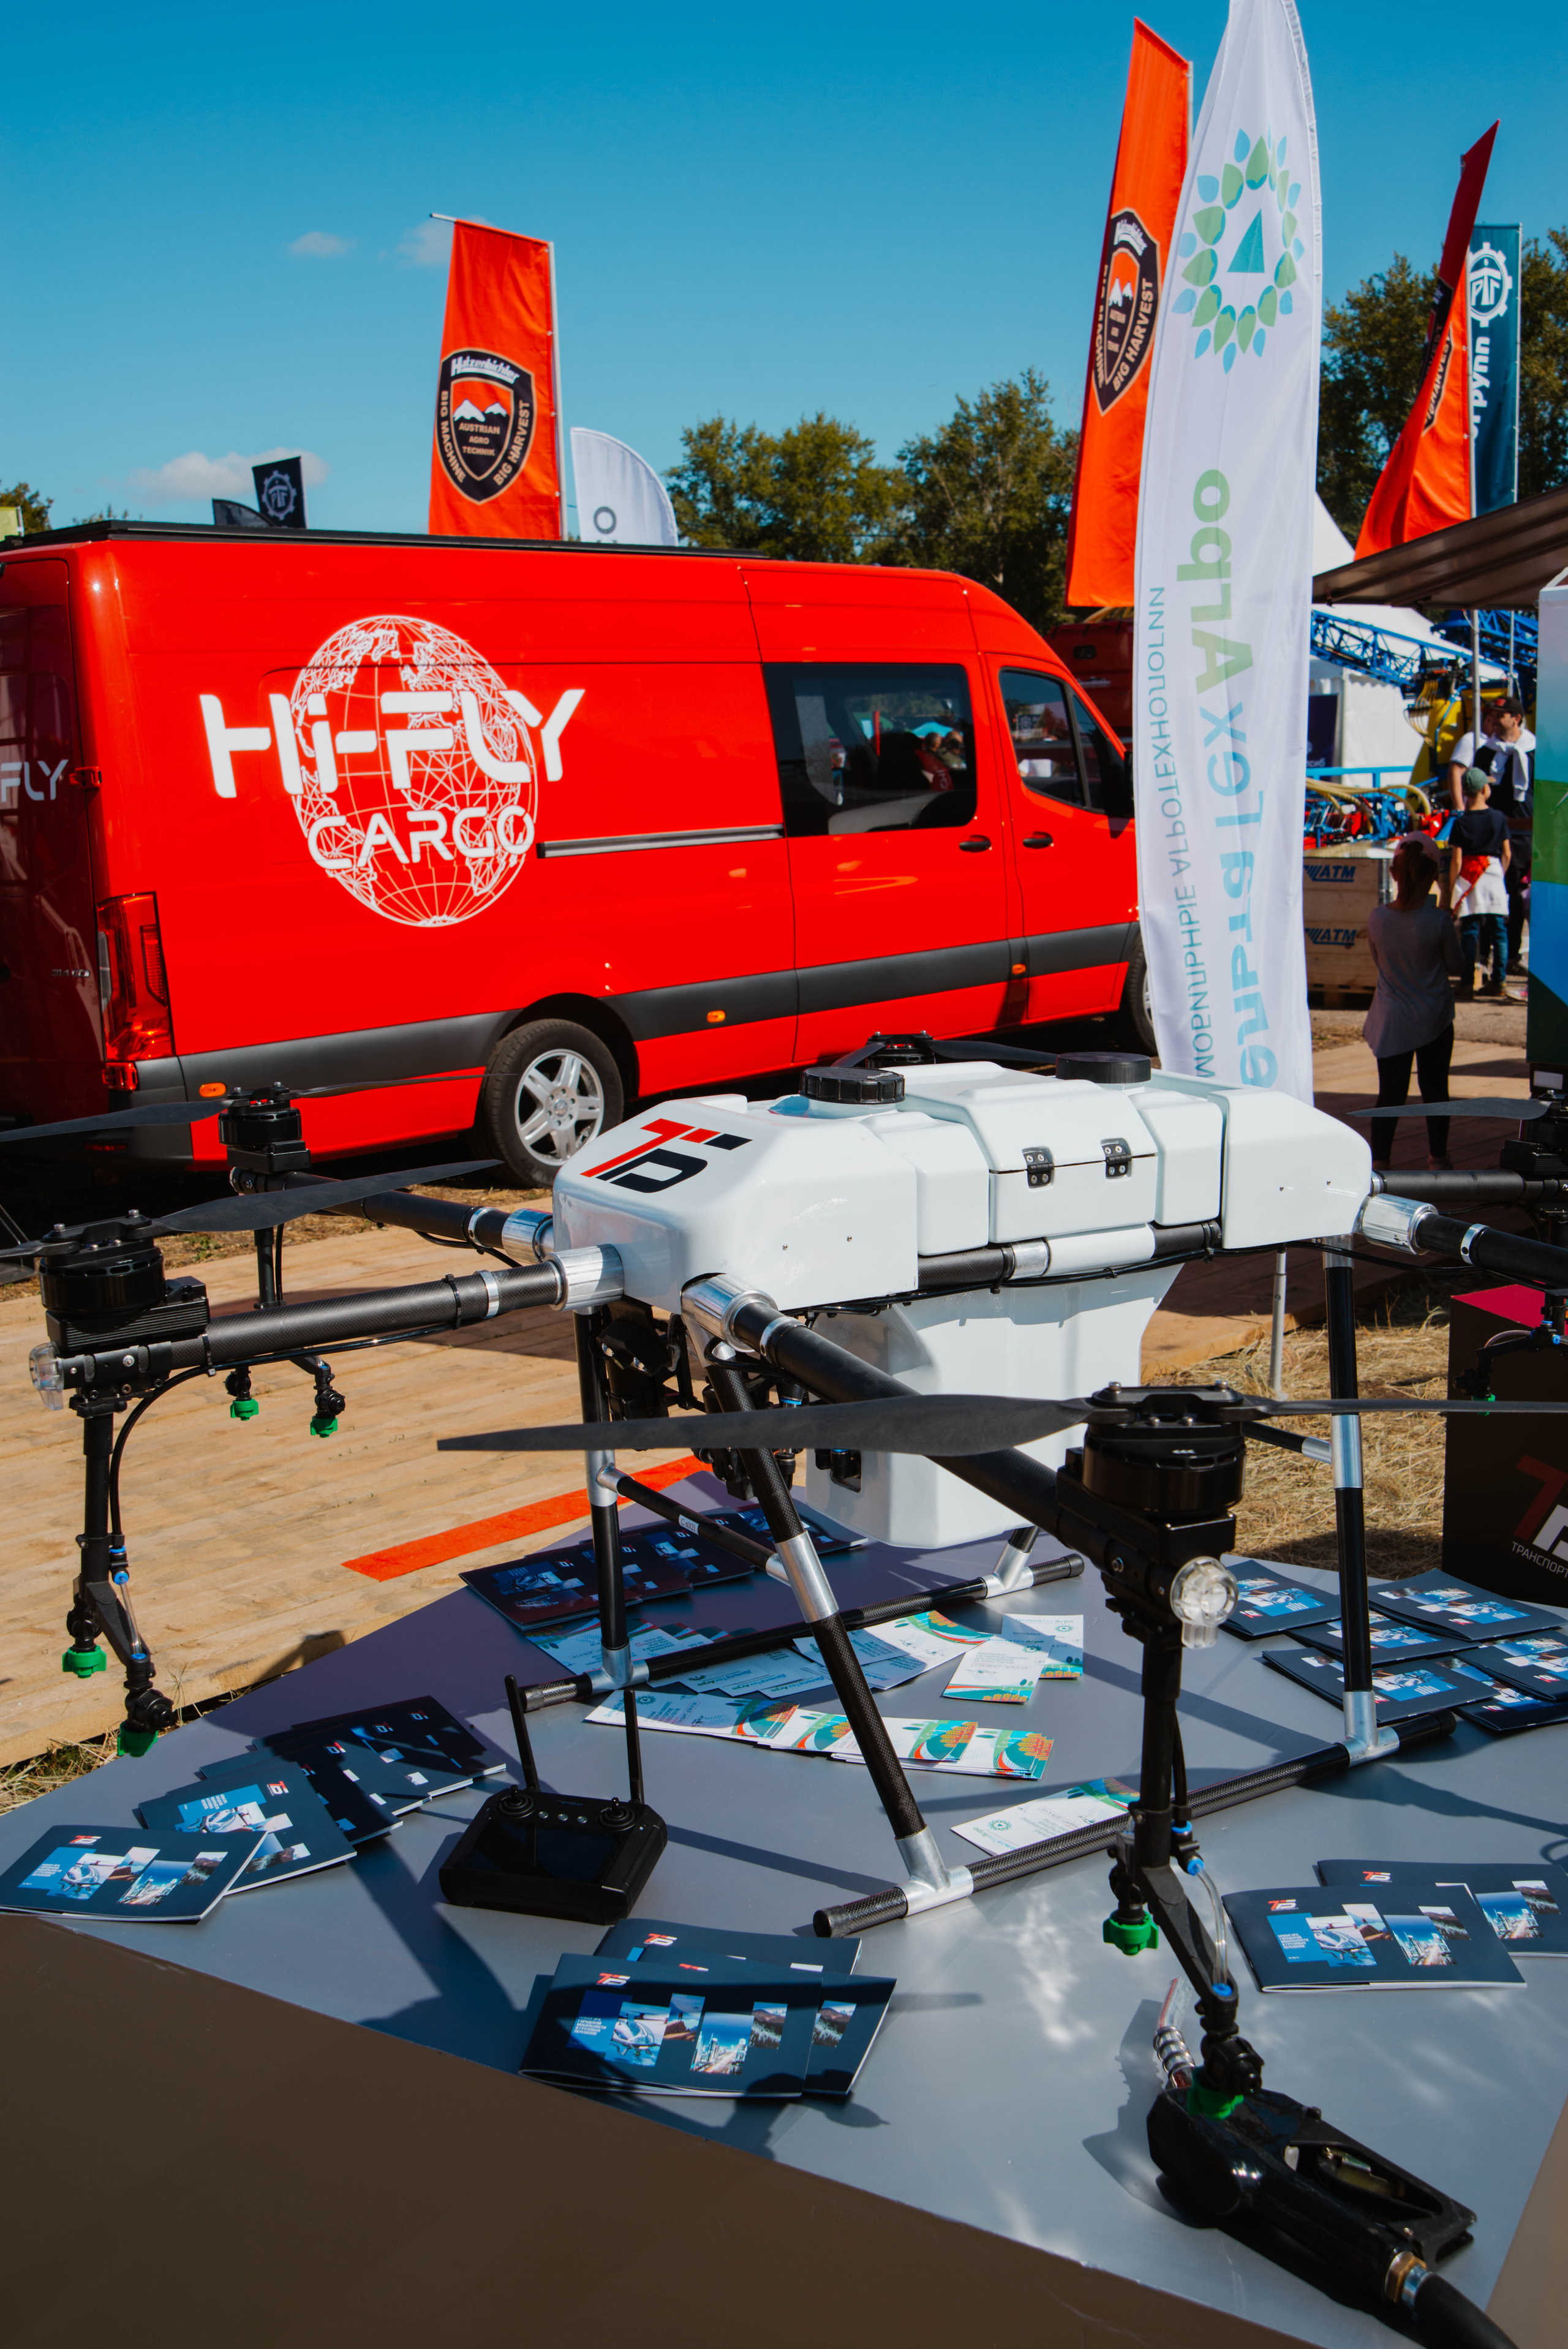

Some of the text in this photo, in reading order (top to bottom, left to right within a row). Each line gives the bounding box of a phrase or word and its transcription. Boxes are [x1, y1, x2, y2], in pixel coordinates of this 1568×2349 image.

[1112, 361, 1131, 391] BIG
[1125, 277, 1153, 363] HARVEST
[441, 420, 467, 483] MACHINE
[458, 422, 500, 435] AUSTRIAN
[462, 446, 496, 457] TECHNIK
[469, 435, 489, 445] AGRO
[492, 399, 530, 486] BIG HARVEST
[307, 804, 535, 870] CARGO
[1512, 1540, 1568, 1578] ТРАНСПОРТ
